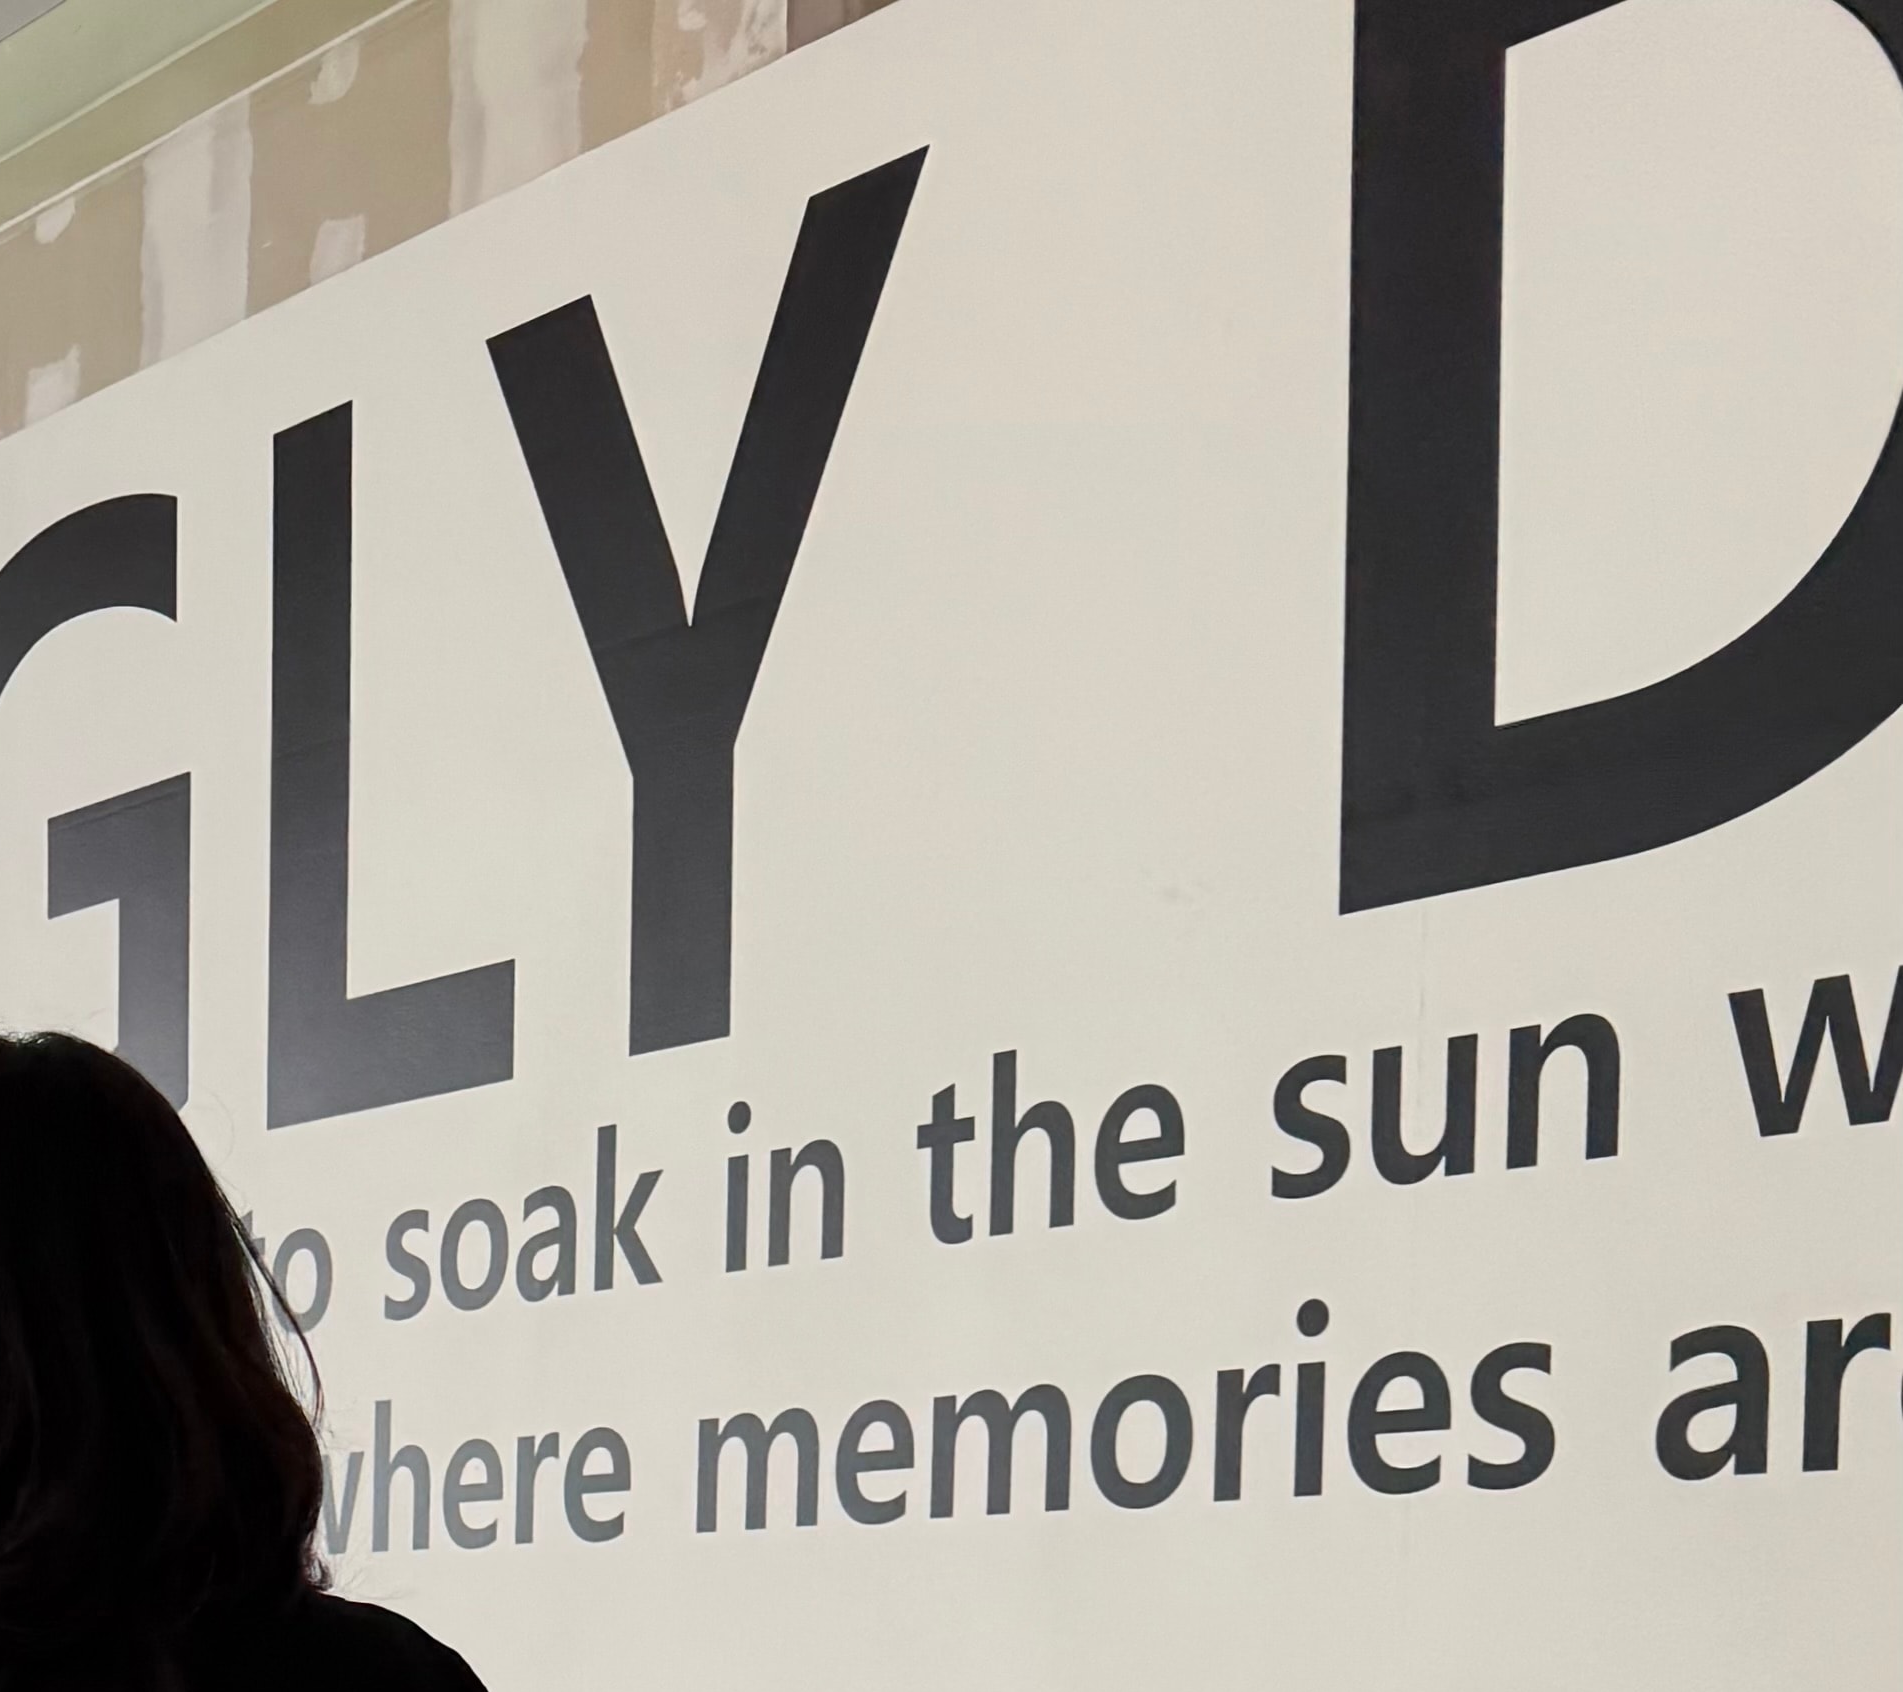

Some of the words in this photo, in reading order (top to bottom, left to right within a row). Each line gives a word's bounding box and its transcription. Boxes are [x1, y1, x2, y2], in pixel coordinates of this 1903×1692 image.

[1339, 0, 1903, 916] D
[383, 1123, 665, 1321] soak
[725, 1100, 846, 1274] in
[916, 1050, 1186, 1245] the
[1271, 1013, 1621, 1200] sun
[695, 1298, 1557, 1534] memories
[1655, 1312, 1903, 1481] ar
